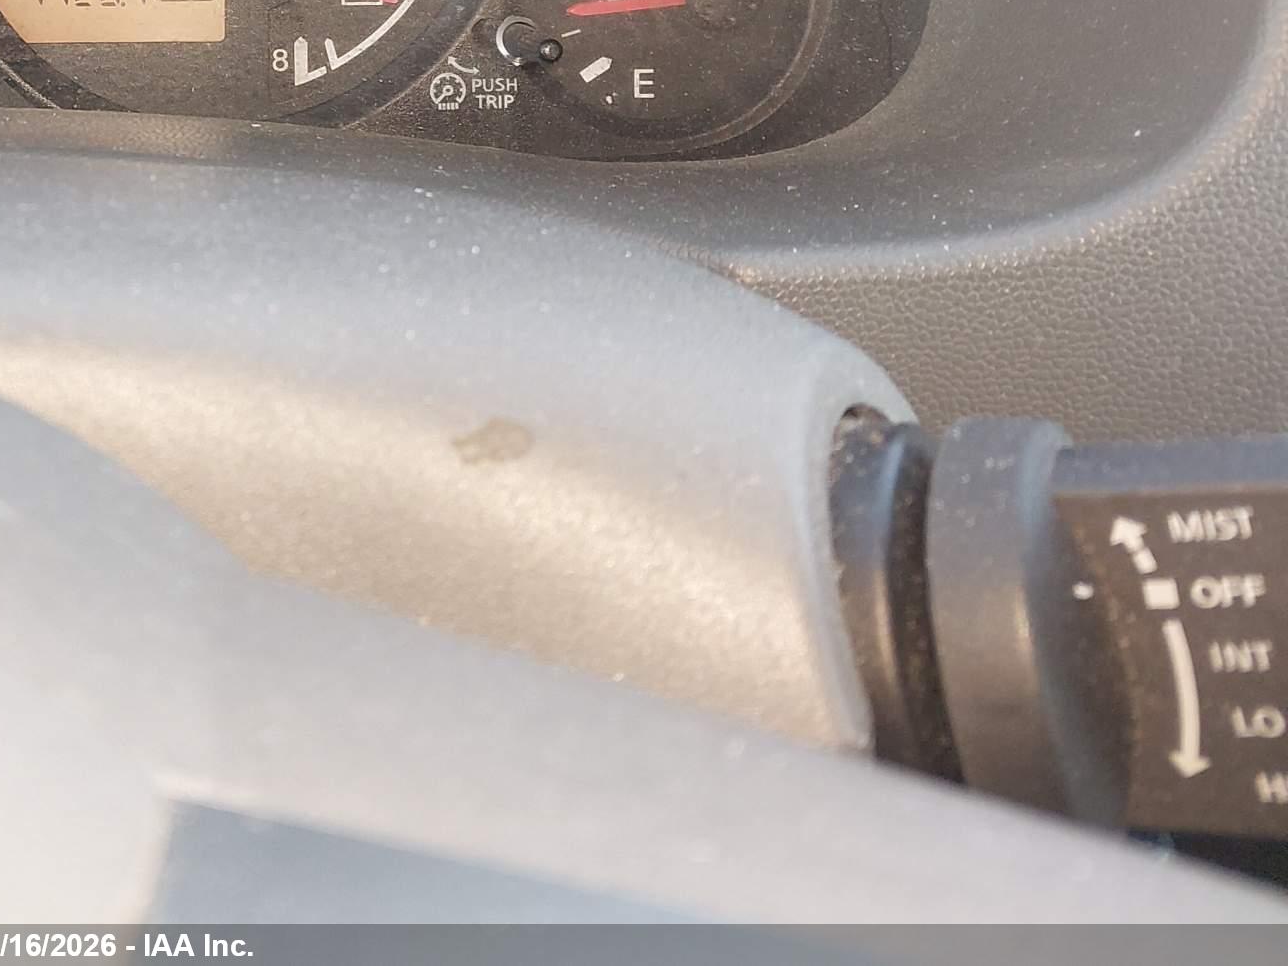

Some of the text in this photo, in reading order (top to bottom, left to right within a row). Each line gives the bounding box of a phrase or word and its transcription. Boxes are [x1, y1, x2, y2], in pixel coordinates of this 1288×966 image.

[272, 48, 289, 72] 8
[471, 77, 518, 93] PUSH
[633, 68, 655, 99] E
[475, 94, 515, 109] TRIP
[1166, 504, 1255, 544] MIST
[1189, 573, 1266, 610] OFF
[1209, 639, 1273, 673] INT
[1230, 705, 1287, 739] LO
[1255, 772, 1288, 802] H
